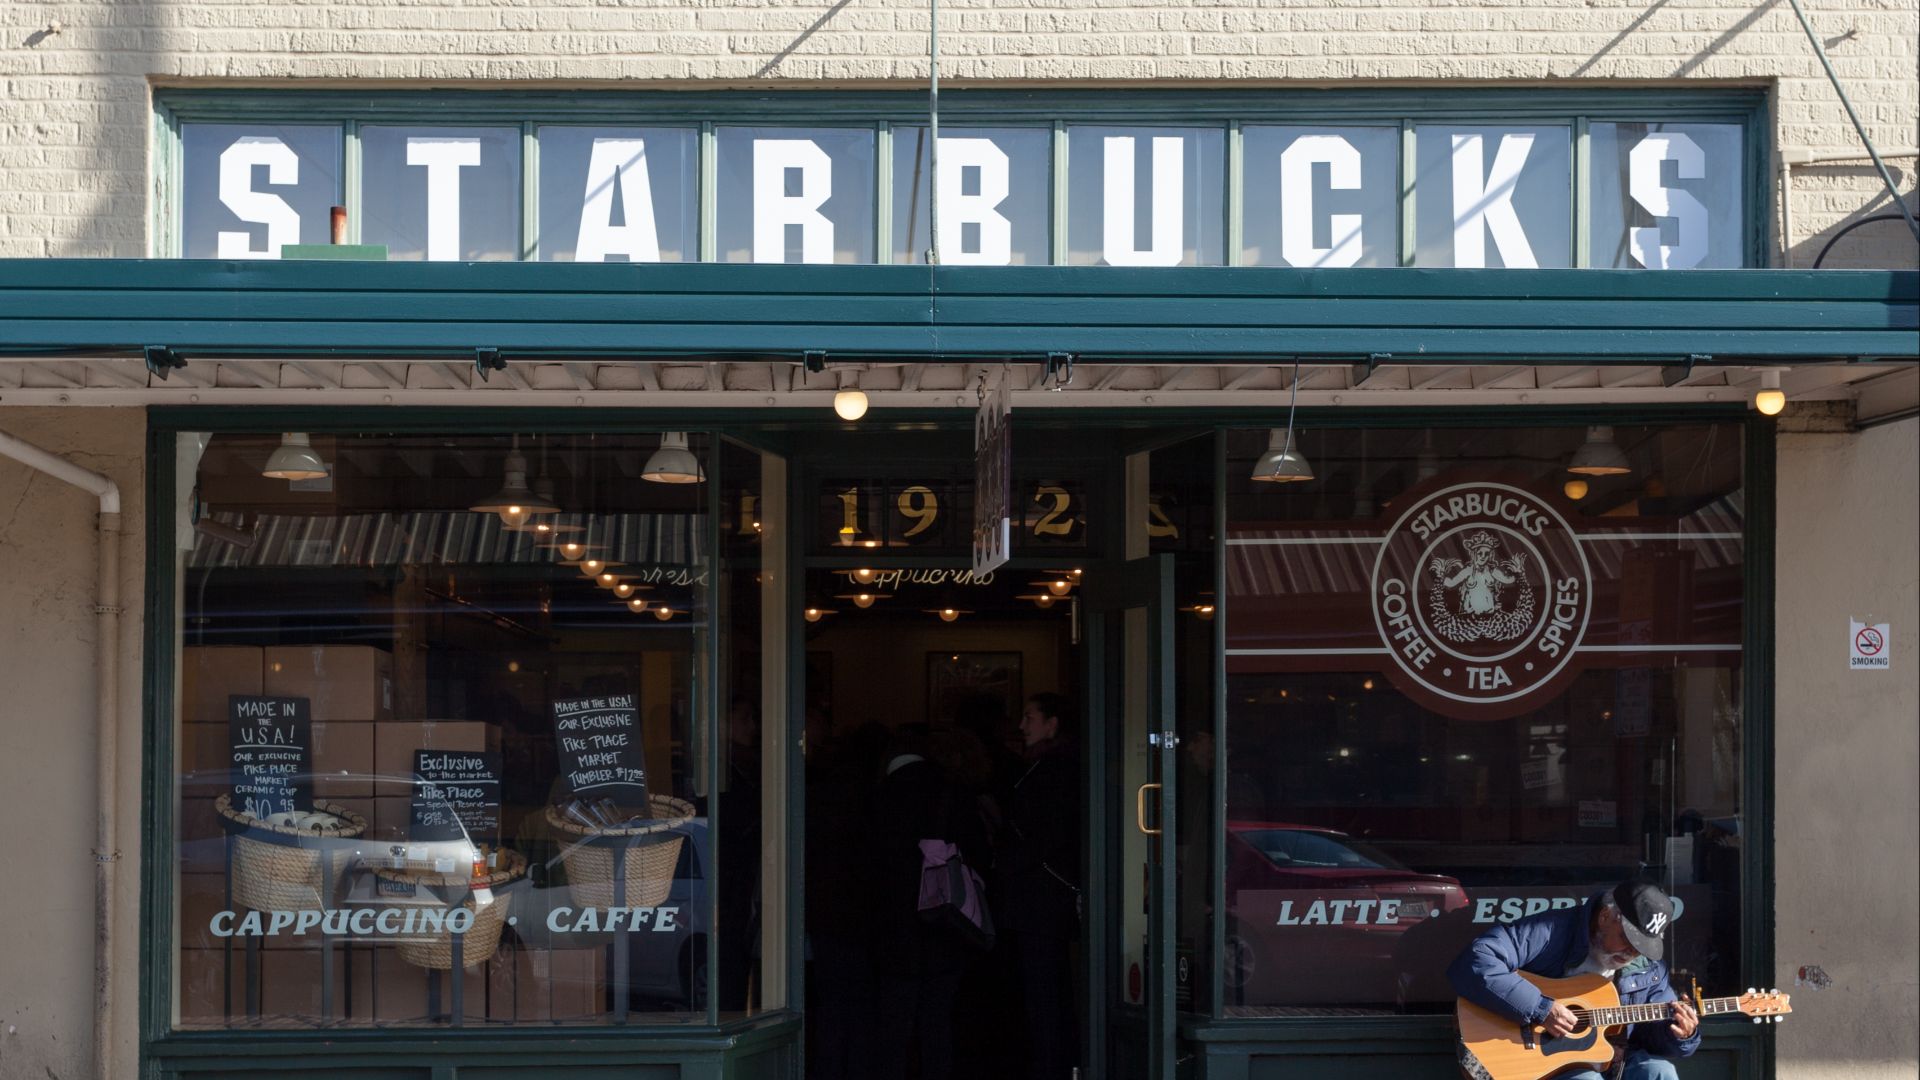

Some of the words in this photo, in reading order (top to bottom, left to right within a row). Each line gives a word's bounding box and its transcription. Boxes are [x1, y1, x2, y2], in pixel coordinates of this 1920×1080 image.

[217, 132, 1708, 268] STARBUCKS
[1410, 493, 1550, 541] STARBUCKS
[1382, 578, 1437, 671] COFFEE
[1538, 576, 1580, 659] SPICES
[1851, 657, 1888, 666] SMOKING
[1466, 665, 1513, 690] TEA
[237, 701, 277, 718] MADE
[283, 702, 296, 717] IN
[554, 701, 580, 714] MADE
[580, 699, 590, 710] IN
[591, 698, 606, 709] THE
[608, 694, 633, 708] USA!
[558, 718, 581, 731] OUR
[581, 713, 633, 730] EXCLUSIVE
[241, 724, 295, 745] USA!
[562, 736, 588, 753] PIKE
[588, 733, 629, 750] PLACE
[234, 752, 254, 762] OUR
[420, 753, 485, 771] Exclusive
[577, 751, 622, 768] MARKET
[243, 764, 267, 776] PIKE
[270, 764, 297, 774] PLACE
[567, 769, 615, 787] TUMBLER
[235, 784, 275, 794] CERAMIC
[279, 787, 298, 797] CUP
[255, 777, 288, 787] MARKET
[422, 784, 446, 799] Pike
[446, 786, 485, 799] Place
[1277, 898, 1401, 926] LATTE
[209, 906, 475, 938] CAPPUCCINO
[547, 906, 680, 932] CAFFE
